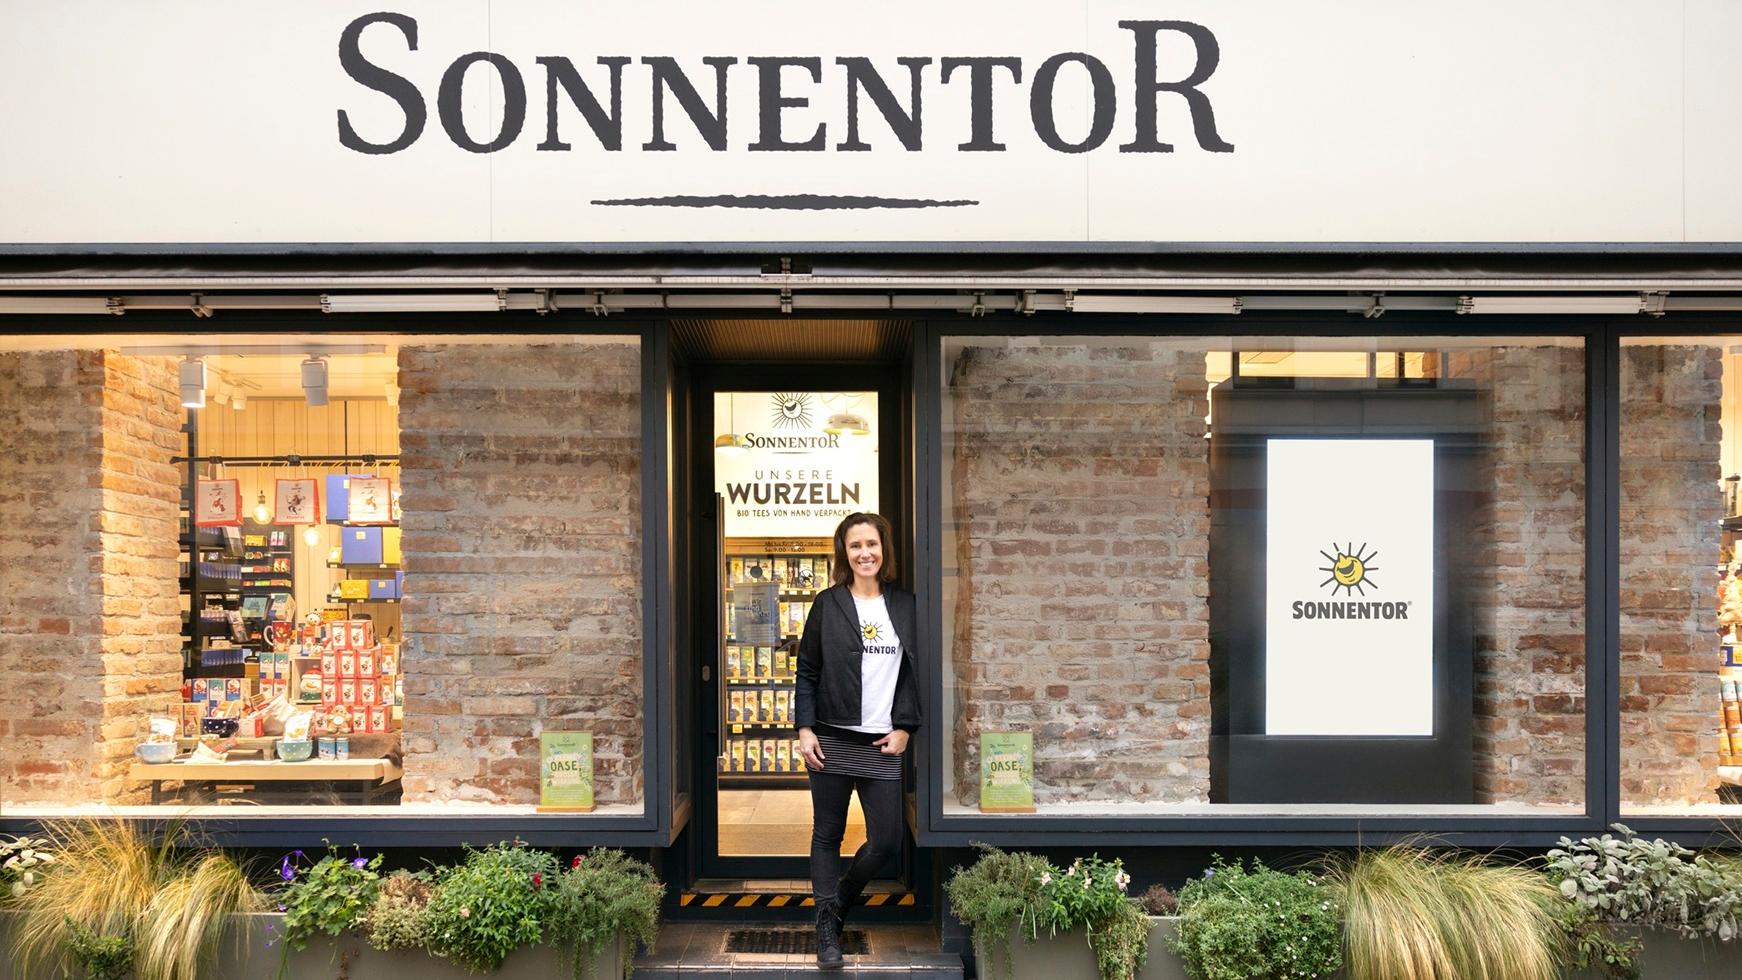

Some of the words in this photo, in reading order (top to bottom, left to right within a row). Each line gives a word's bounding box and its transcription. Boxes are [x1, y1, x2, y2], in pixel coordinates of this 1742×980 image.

[337, 11, 1235, 155] SONNENTOR
[755, 470, 833, 480] UNSERE
[726, 483, 860, 505] WURZELN
